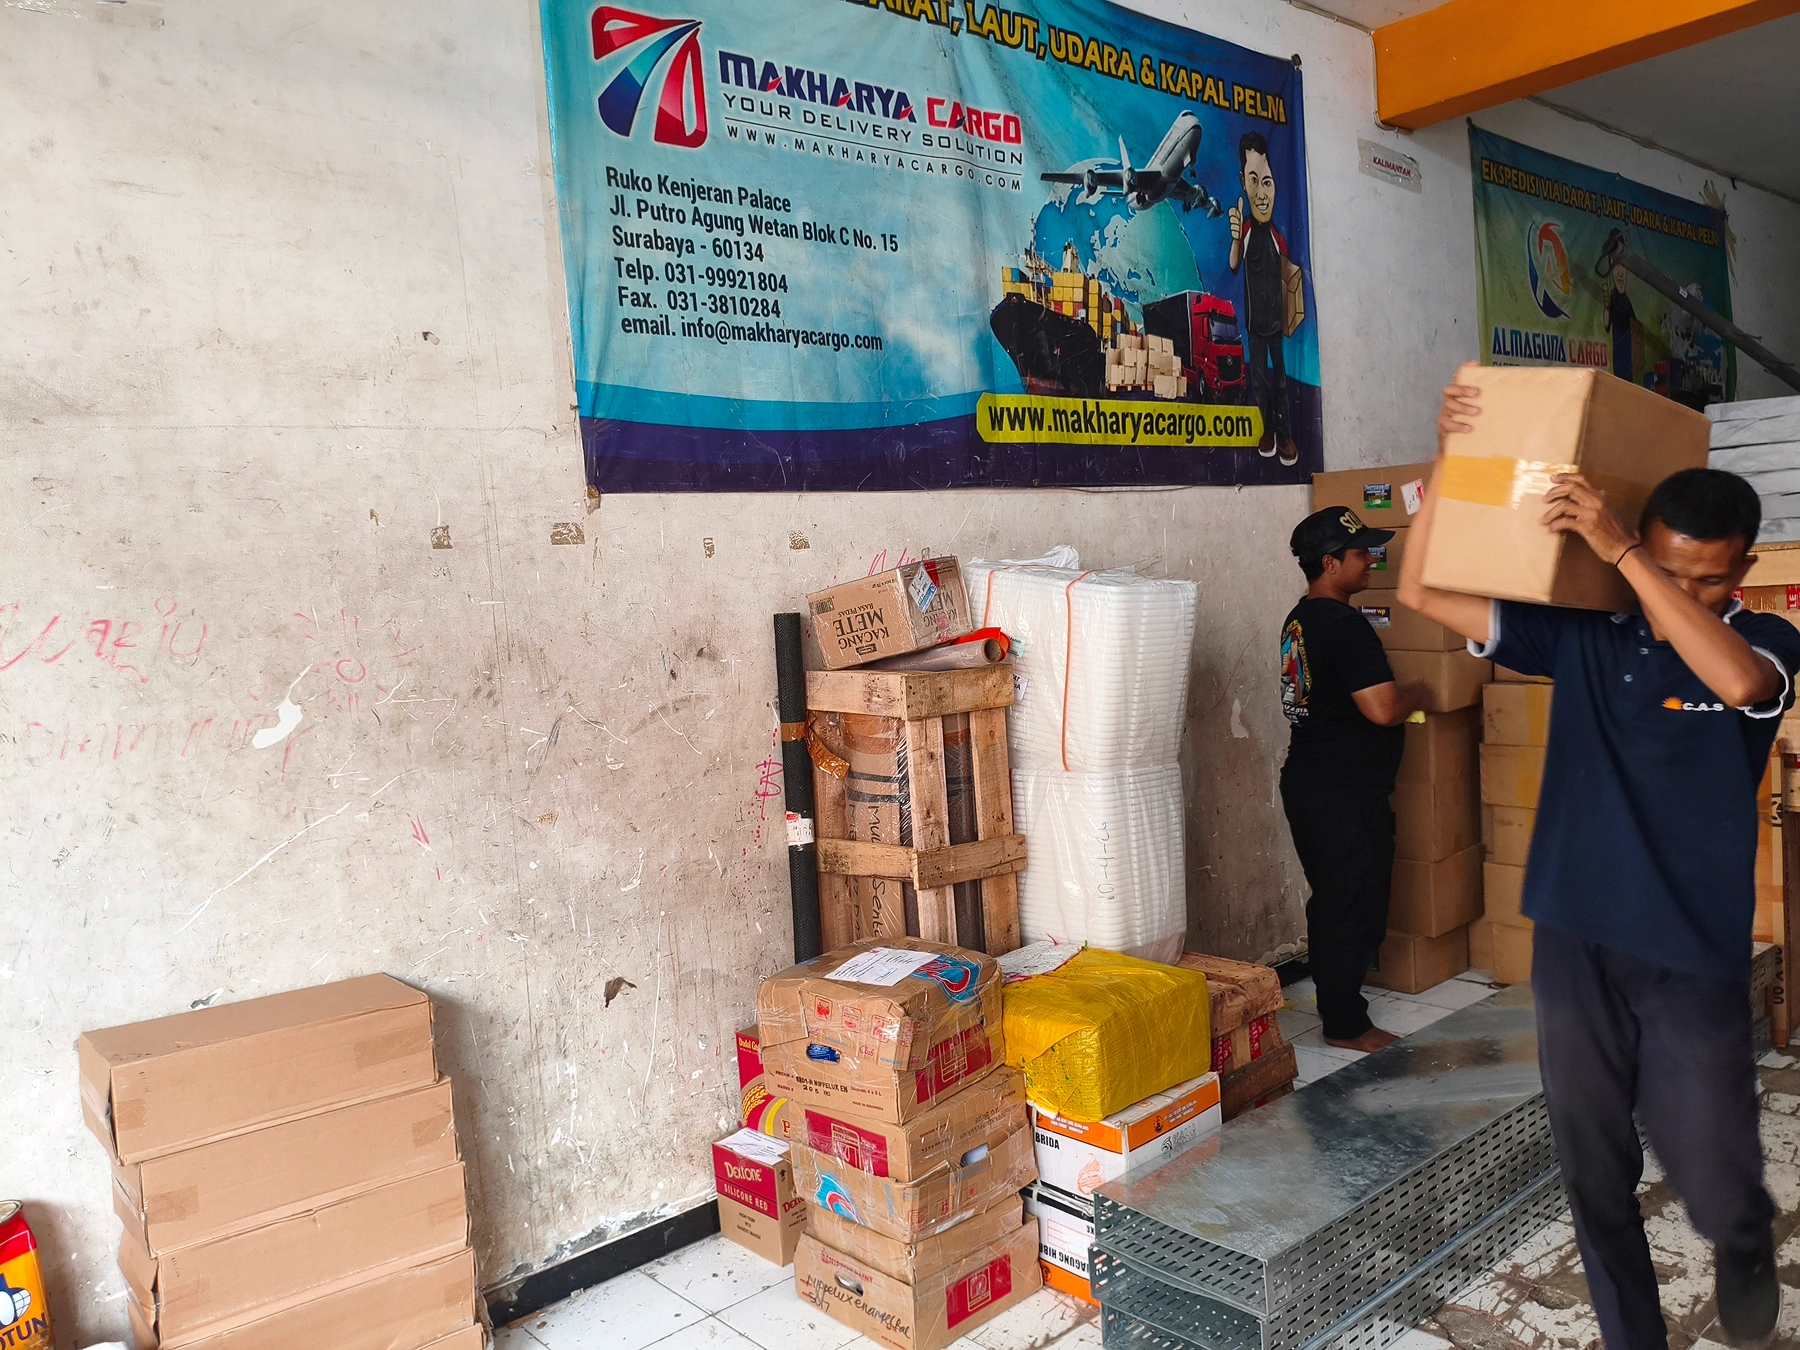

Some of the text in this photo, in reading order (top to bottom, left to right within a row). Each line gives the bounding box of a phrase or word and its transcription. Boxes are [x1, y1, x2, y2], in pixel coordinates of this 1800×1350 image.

[966, 1, 1046, 60] LAUT,
[1049, 27, 1135, 78] UDARA
[1140, 56, 1155, 87] &
[1161, 62, 1230, 108] KAPAL
[719, 51, 1022, 144] MAKHARYA CARGO
[724, 93, 1023, 165] YOUR DELIVERY SOLUTION
[606, 166, 791, 213] Ruko Kenjeran Palace
[1481, 158, 1540, 197] EKSPEDISI
[1541, 179, 1560, 202] VIA
[1630, 205, 1661, 231] UDARA
[612, 225, 695, 258] Surabaya
[712, 238, 764, 263] 60134
[637, 198, 686, 224] Putro
[692, 206, 744, 237] Agung
[748, 213, 798, 239] Wetan
[803, 221, 837, 245] Blok
[839, 227, 849, 245] C
[853, 229, 877, 250] No.
[881, 233, 899, 252] 15
[614, 256, 788, 293] Telp. 031-99921804
[617, 286, 781, 319] Fax. 031-3810284
[621, 314, 883, 352] email. info@makharyacargo.com
[1568, 337, 1608, 367] CARGO
[988, 401, 1253, 444] www.makharyacargo.com
[832, 608, 885, 638] METE
[838, 626, 890, 650] KACANG
[724, 1183, 768, 1211] SILICONE RED
